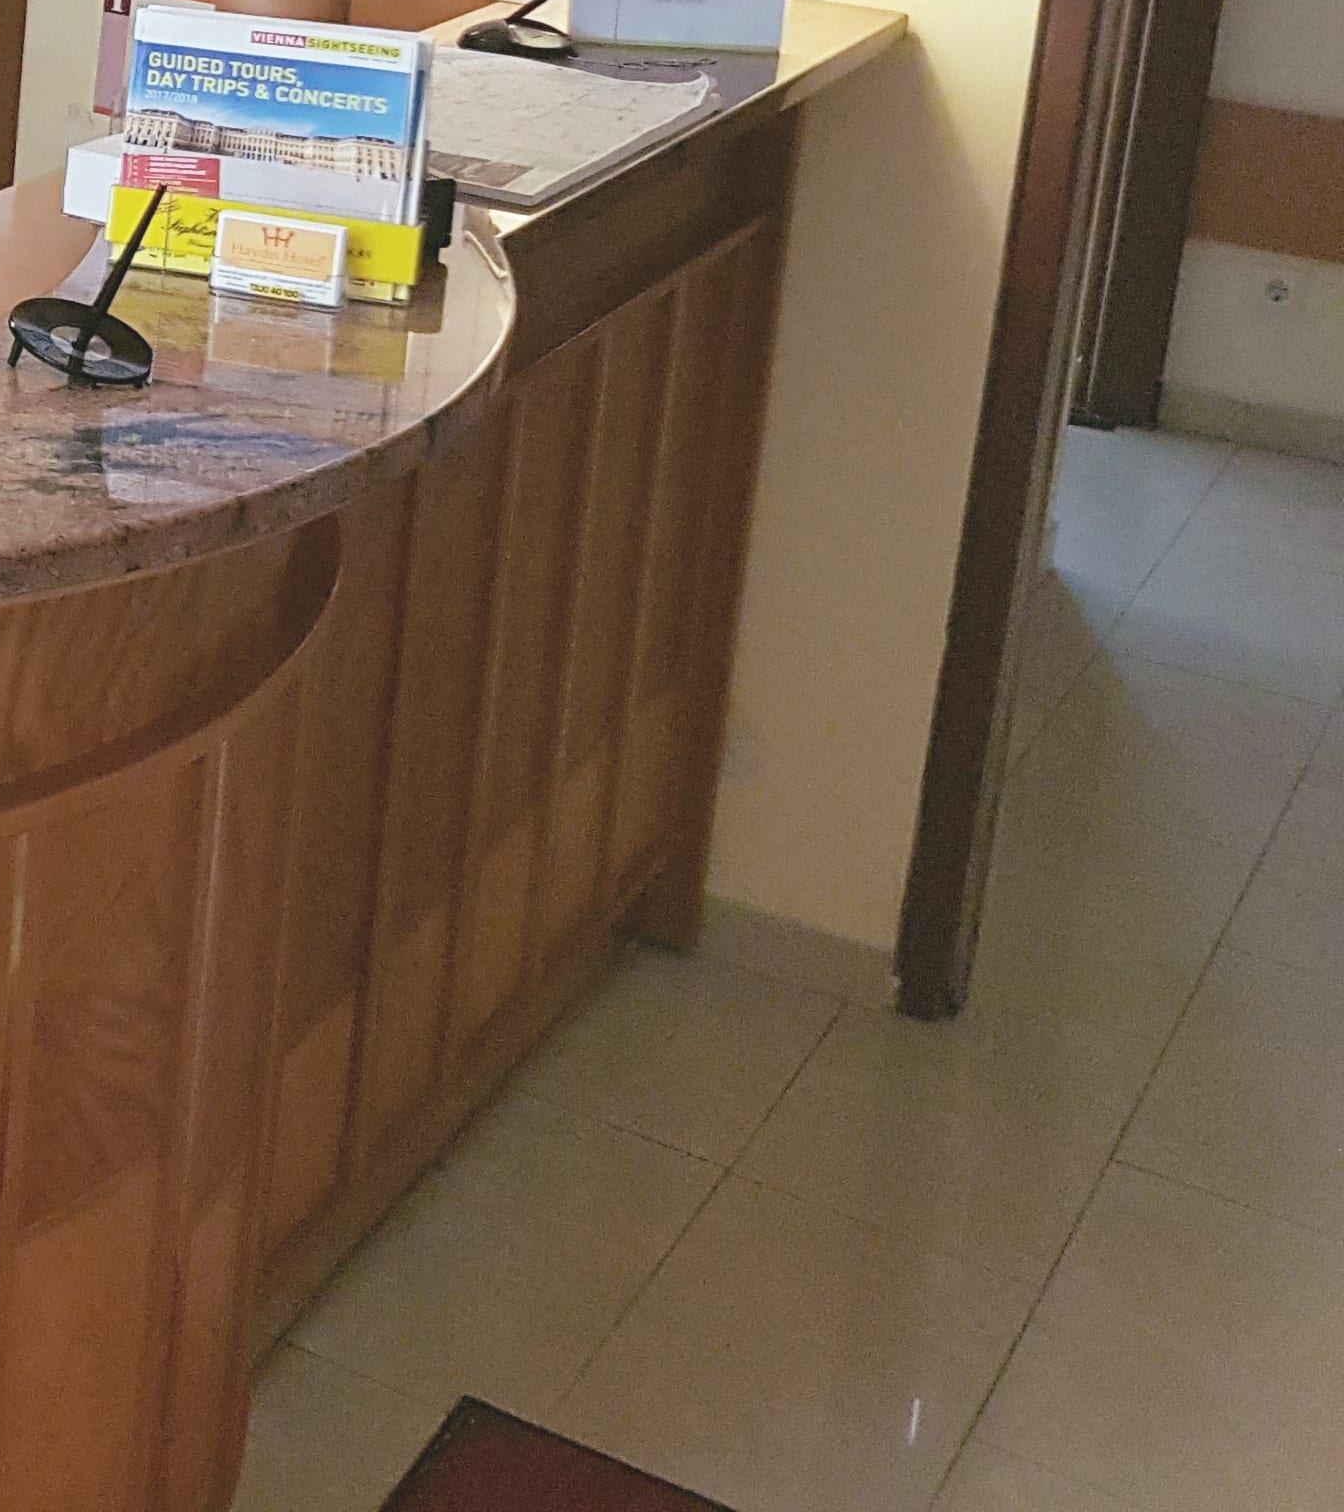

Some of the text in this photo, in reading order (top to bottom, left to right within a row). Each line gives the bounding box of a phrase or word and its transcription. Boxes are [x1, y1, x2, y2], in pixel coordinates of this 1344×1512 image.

[252, 31, 401, 59] VIENNA SIGHTSEEING
[148, 51, 304, 87] GUIDED TOURS,
[144, 89, 199, 105] 2017/2018
[146, 70, 389, 115] DAY TRIPS & CONCERTS
[231, 242, 279, 261] Haydn
